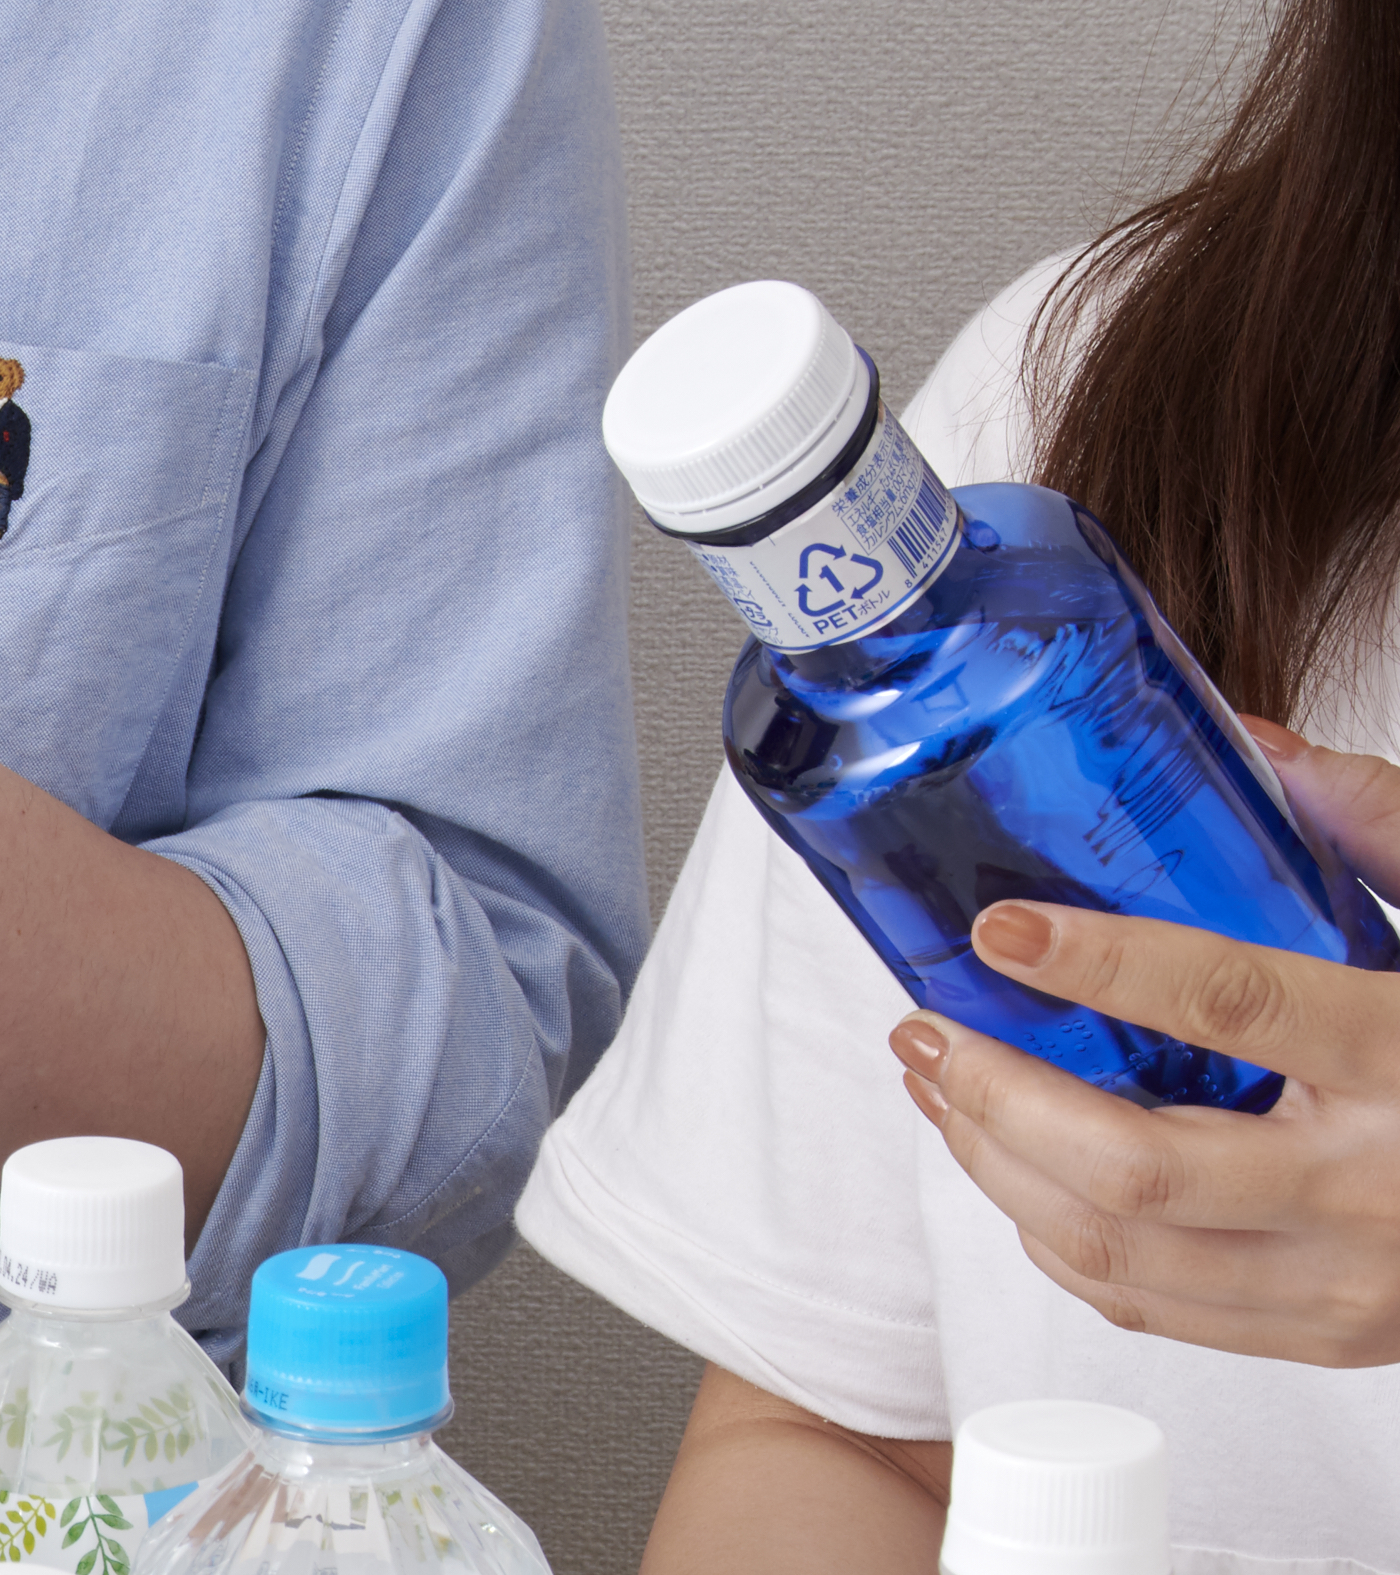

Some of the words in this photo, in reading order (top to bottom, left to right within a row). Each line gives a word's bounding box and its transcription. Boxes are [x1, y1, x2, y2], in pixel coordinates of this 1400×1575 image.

[816, 564, 845, 597] 1
[813, 604, 863, 635] PET
[854, 587, 894, 617] ボトル
